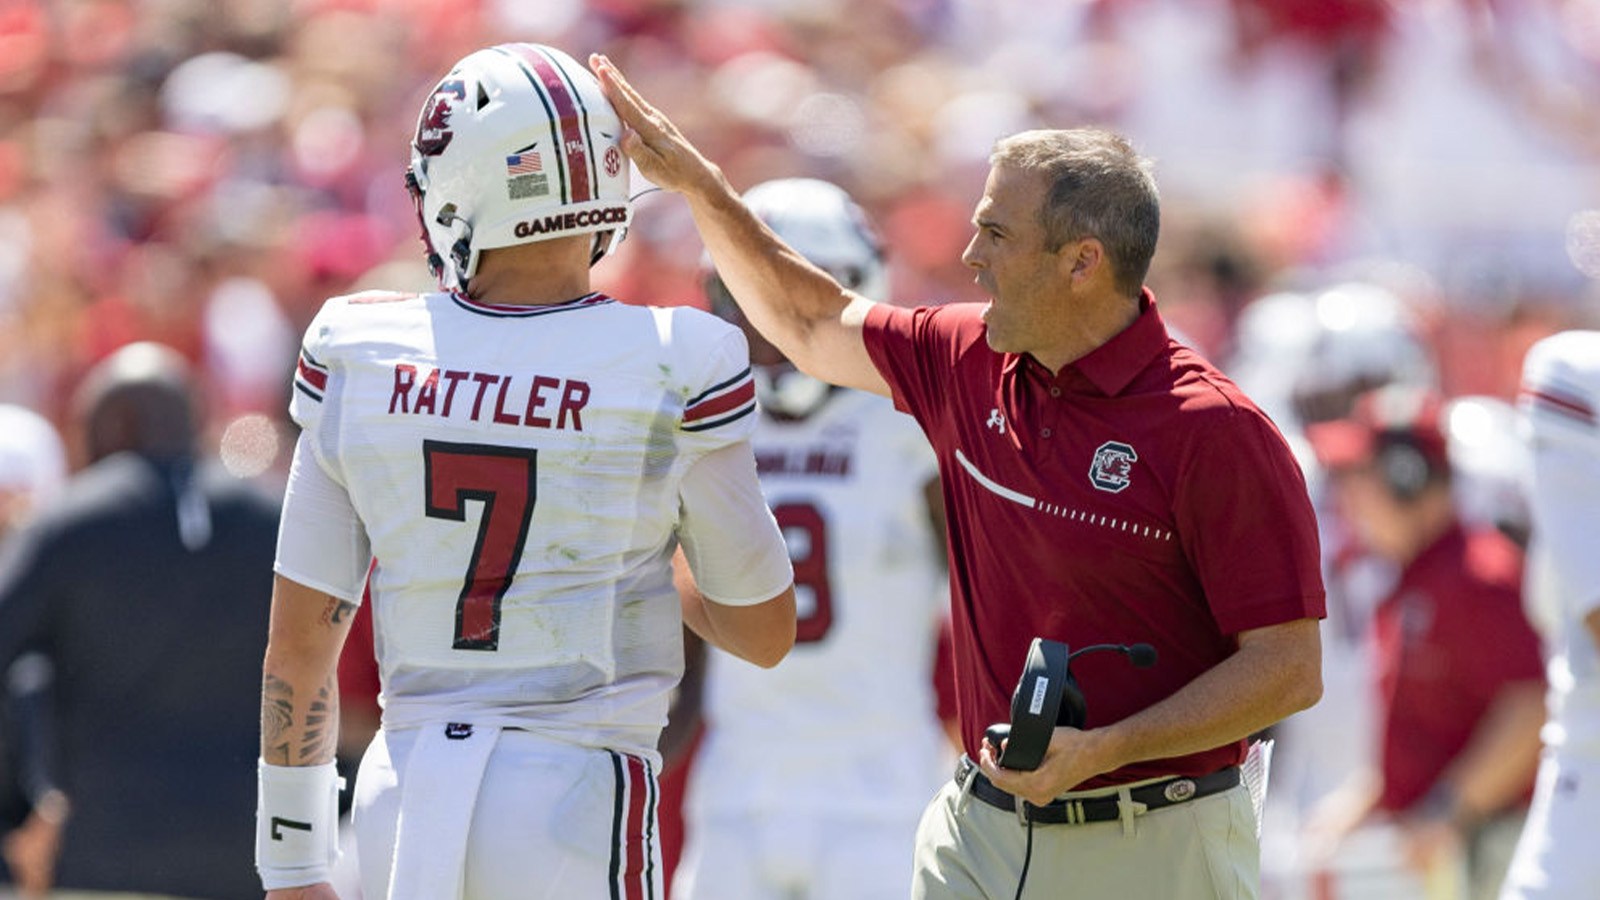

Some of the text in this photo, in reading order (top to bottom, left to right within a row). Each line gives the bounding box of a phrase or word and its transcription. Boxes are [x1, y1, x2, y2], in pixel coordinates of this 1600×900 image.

[514, 207, 627, 238] GAMECOCKS
[388, 363, 591, 431] RATTLER
[423, 439, 538, 651] 7
[271, 816, 313, 842] 7
